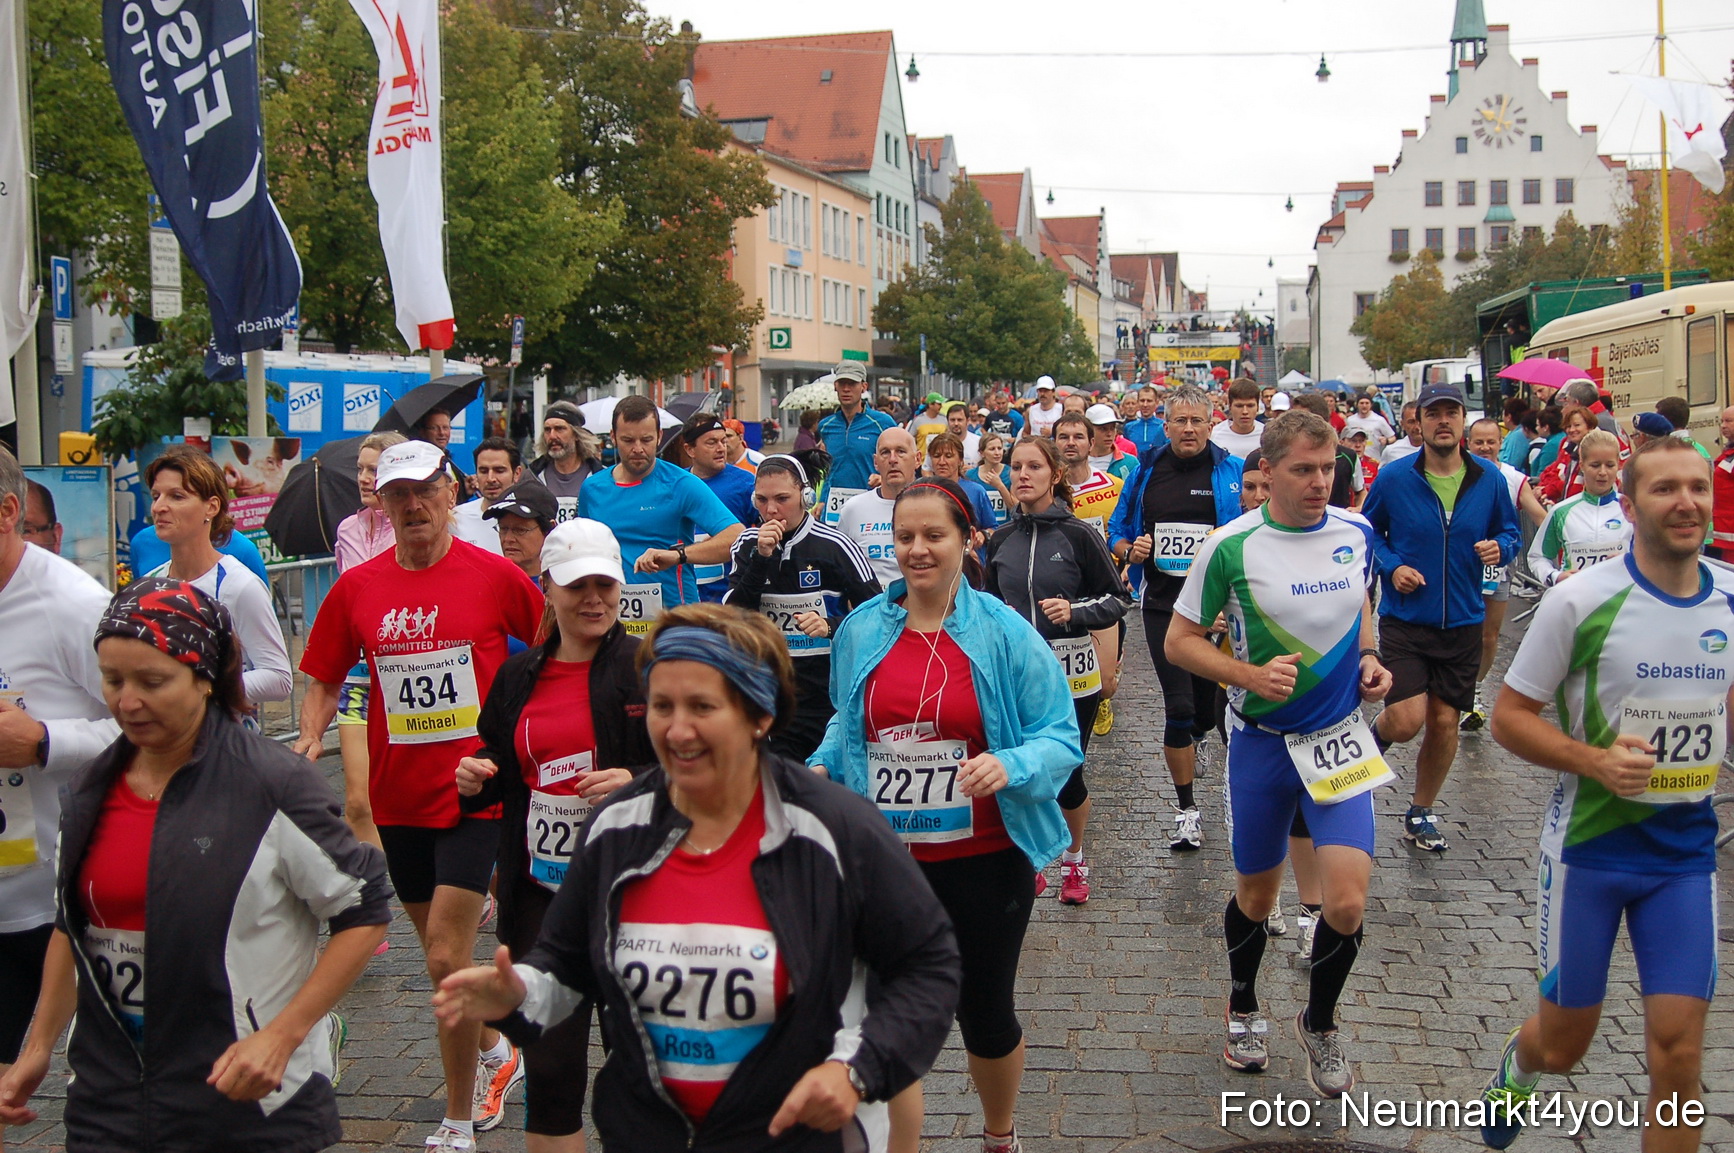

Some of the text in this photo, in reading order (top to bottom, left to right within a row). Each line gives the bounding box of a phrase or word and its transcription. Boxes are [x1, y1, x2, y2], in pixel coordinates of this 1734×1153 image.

[56, 265, 68, 312] P
[1179, 349, 1210, 359] START
[1608, 336, 1660, 364] Bayerisches
[1608, 366, 1632, 386] Rotes
[1085, 489, 1118, 505] BÖGL
[1291, 577, 1351, 596] Michael
[378, 641, 434, 654] COMMITTED
[379, 658, 455, 673] PARTL Neumarkt
[1636, 662, 1726, 680] Sebastian
[399, 672, 458, 709] 434
[1073, 681, 1087, 690] Eva
[406, 713, 456, 731] Michael
[1624, 708, 1716, 720] PARTL Neumarkt
[1288, 720, 1352, 749] PARTL Neumarkt
[1645, 723, 1713, 763] 423
[869, 752, 948, 763] PARTL Neumarkt
[1313, 731, 1363, 771] 425
[550, 761, 576, 777] DEHN
[1329, 765, 1371, 791] Michael
[875, 765, 958, 804] 2277
[1649, 773, 1710, 789] ebastian
[531, 800, 553, 815] PARTL
[892, 814, 942, 830] Nadine
[616, 939, 742, 957] PARTL Neumarkt
[622, 960, 757, 1021] 2276
[664, 1033, 716, 1060] Rosa
